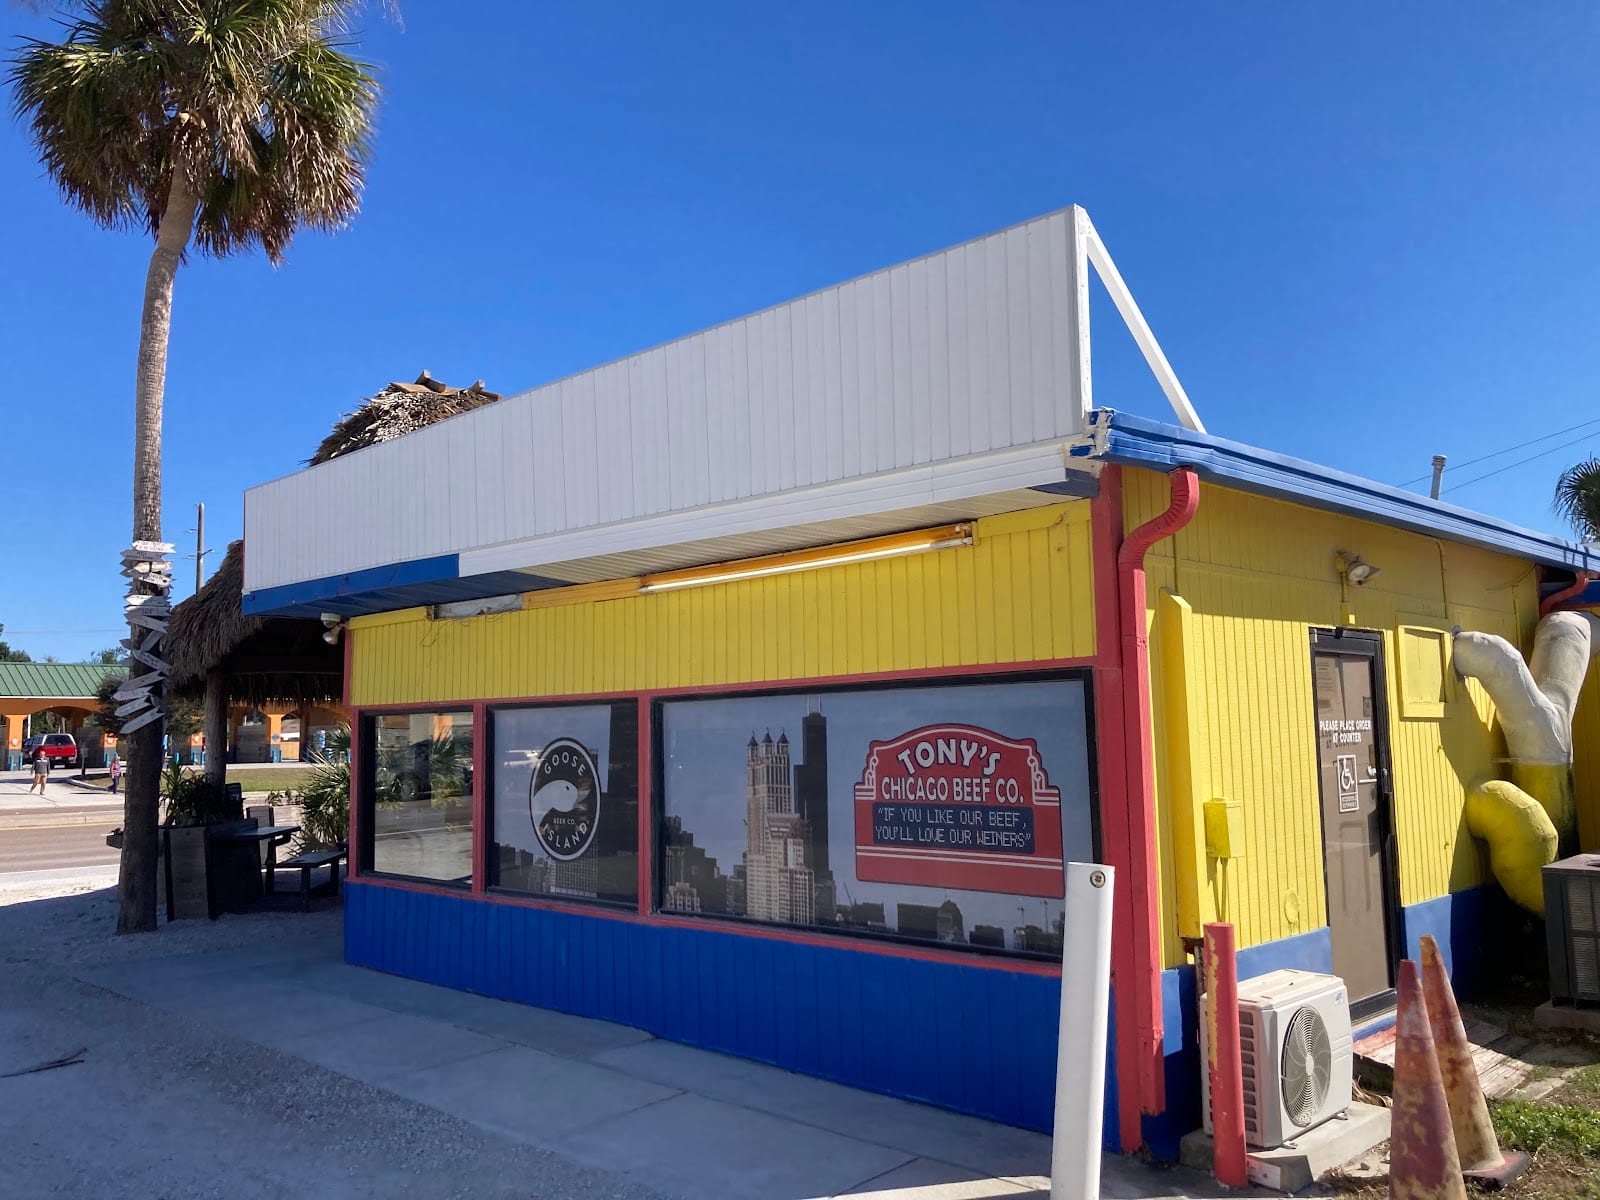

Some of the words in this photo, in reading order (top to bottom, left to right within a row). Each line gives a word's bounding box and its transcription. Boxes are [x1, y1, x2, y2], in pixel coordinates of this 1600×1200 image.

[1320, 720, 1338, 731] PLEASE
[1340, 720, 1355, 731] PLACE
[1356, 720, 1371, 730] ORDER
[1332, 733, 1338, 743] AT
[1340, 733, 1361, 743] COUNTER
[544, 751, 586, 776] GOOSE
[897, 738, 1001, 776] TONY'S
[881, 777, 948, 801] CHICAGO
[953, 777, 991, 802] BEEF
[996, 778, 1024, 803] CO.
[553, 817, 566, 825] BEER
[878, 807, 895, 821] "IF
[900, 808, 922, 823] YOU
[928, 809, 954, 824] LIKE
[960, 811, 983, 826] OUR
[989, 812, 1027, 830] BEEF,
[542, 822, 588, 849] ISLAND
[875, 825, 913, 841] YOU'LL
[918, 828, 945, 843] LOVE
[950, 829, 972, 844] OUR
